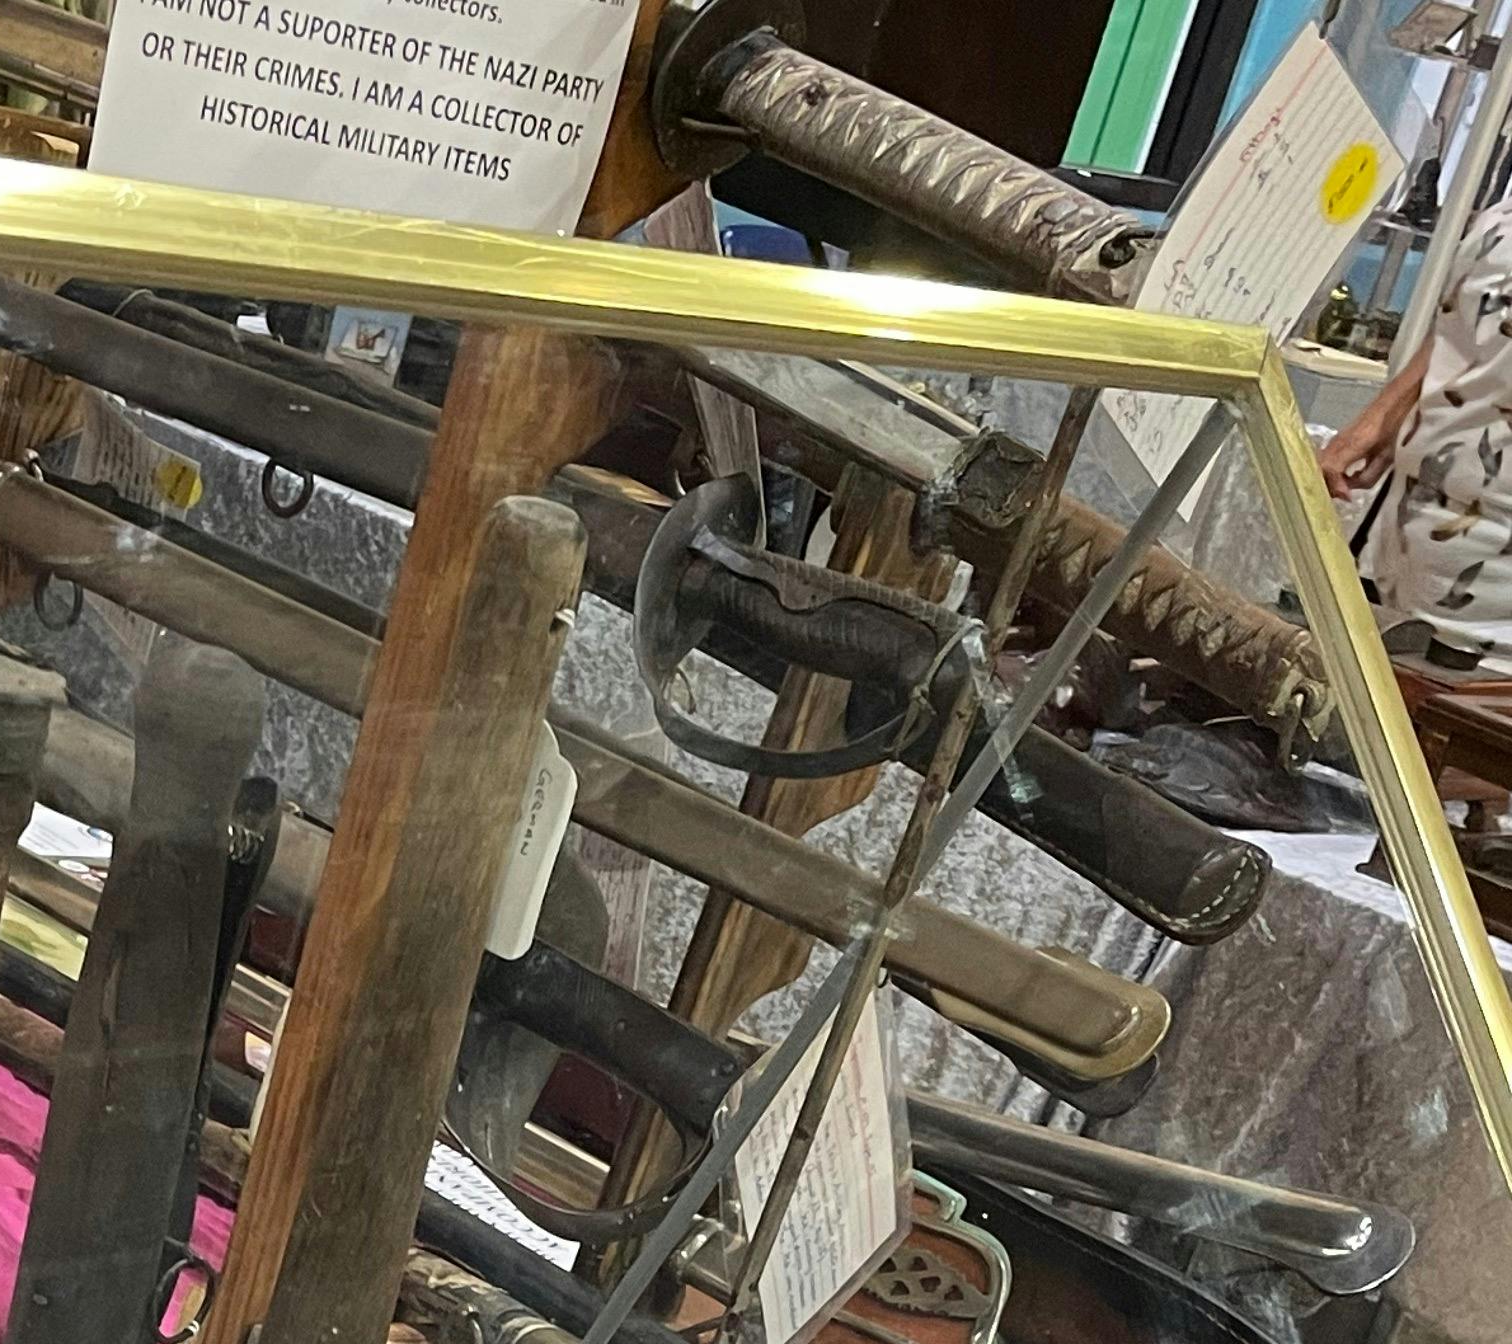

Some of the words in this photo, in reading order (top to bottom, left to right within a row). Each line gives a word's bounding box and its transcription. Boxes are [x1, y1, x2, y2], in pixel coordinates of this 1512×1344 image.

[142, 32, 175, 61] OR
[183, 39, 247, 77] THEIR
[254, 57, 343, 98] CRIMES.
[352, 77, 360, 101] I
[364, 80, 404, 110] AM
[407, 90, 423, 115] A
[431, 95, 552, 142] COLLECTOR
[557, 122, 584, 148] OF
[199, 0, 251, 25] NOT
[254, 5, 270, 31] A
[277, 10, 396, 58] SUPORTER
[402, 38, 432, 65] OF
[438, 44, 479, 76] THE
[483, 56, 538, 89] NAZI
[541, 69, 604, 104] PARTY
[200, 95, 330, 145] HISTORICAL
[338, 124, 440, 166] MILITARY
[444, 146, 512, 181] ITEMS
